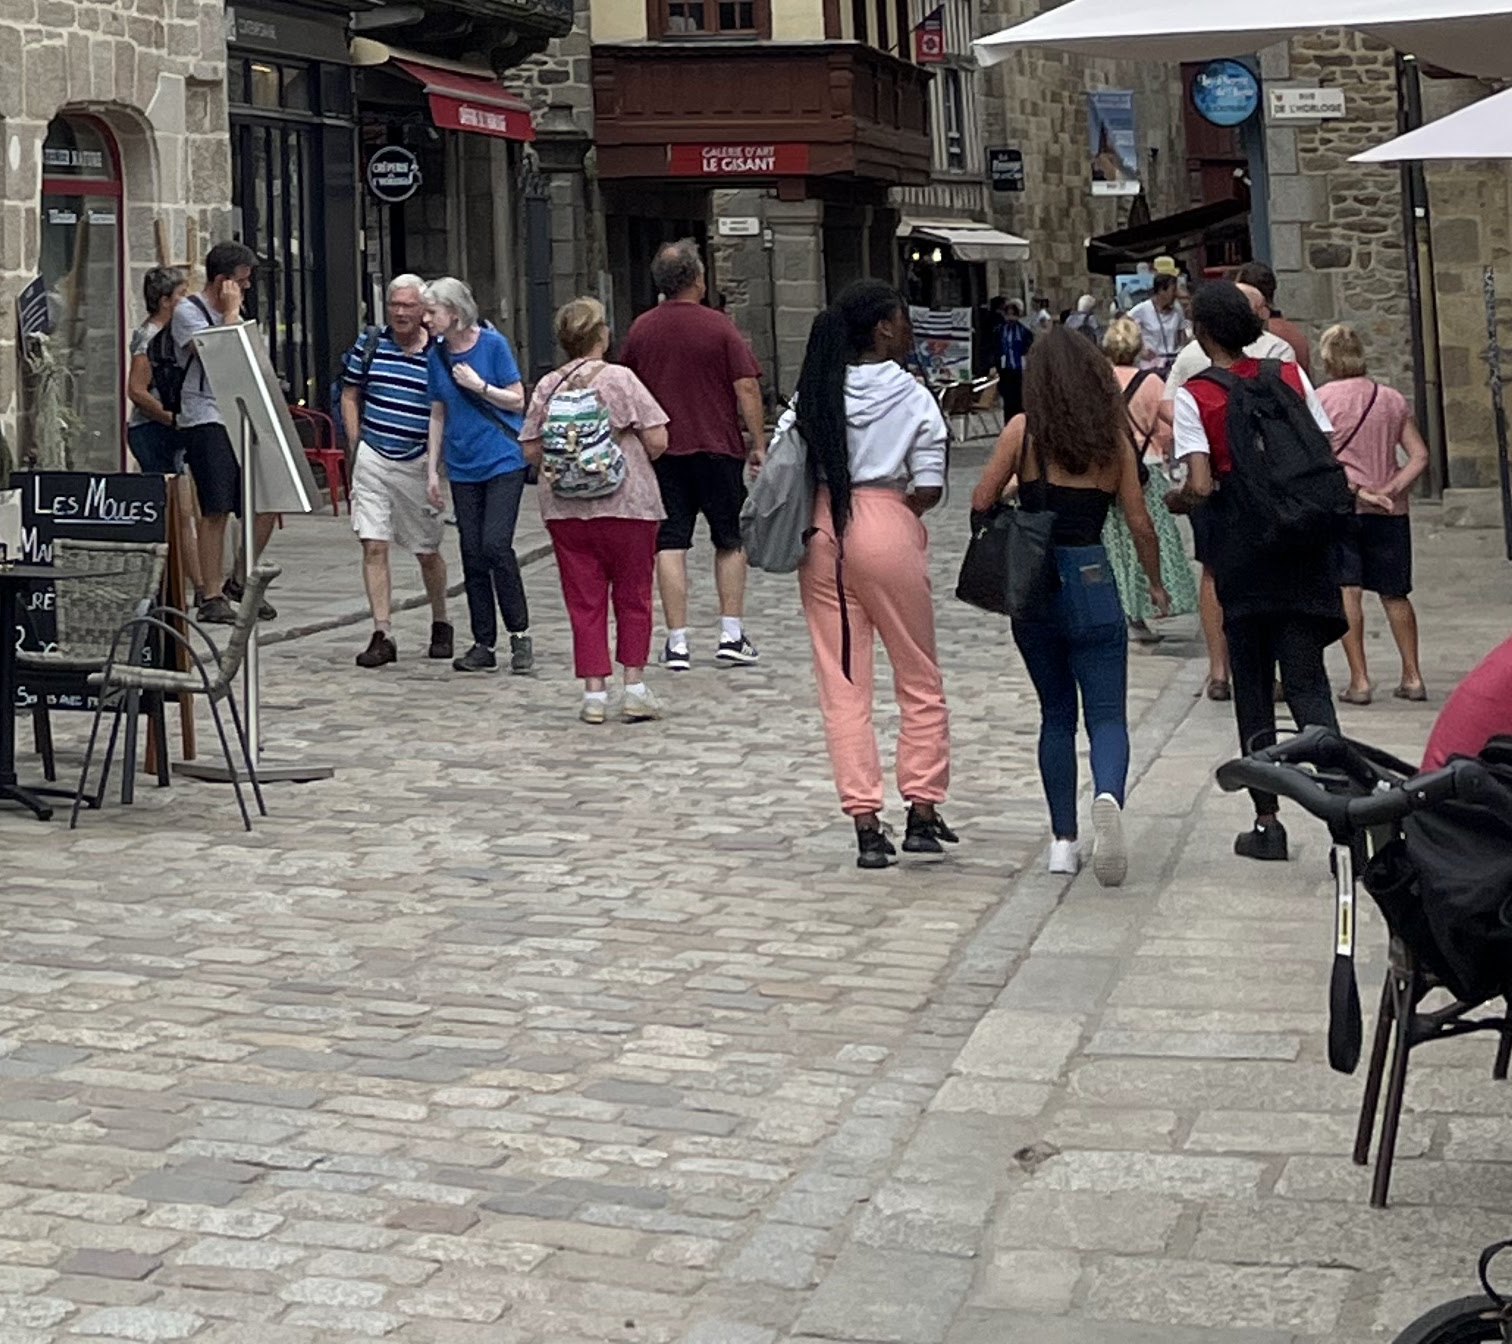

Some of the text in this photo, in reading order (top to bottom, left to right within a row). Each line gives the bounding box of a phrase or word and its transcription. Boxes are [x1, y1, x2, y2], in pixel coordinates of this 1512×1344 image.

[701, 146, 775, 158] GALERIE D'ART
[702, 157, 776, 172] LE GISANT
